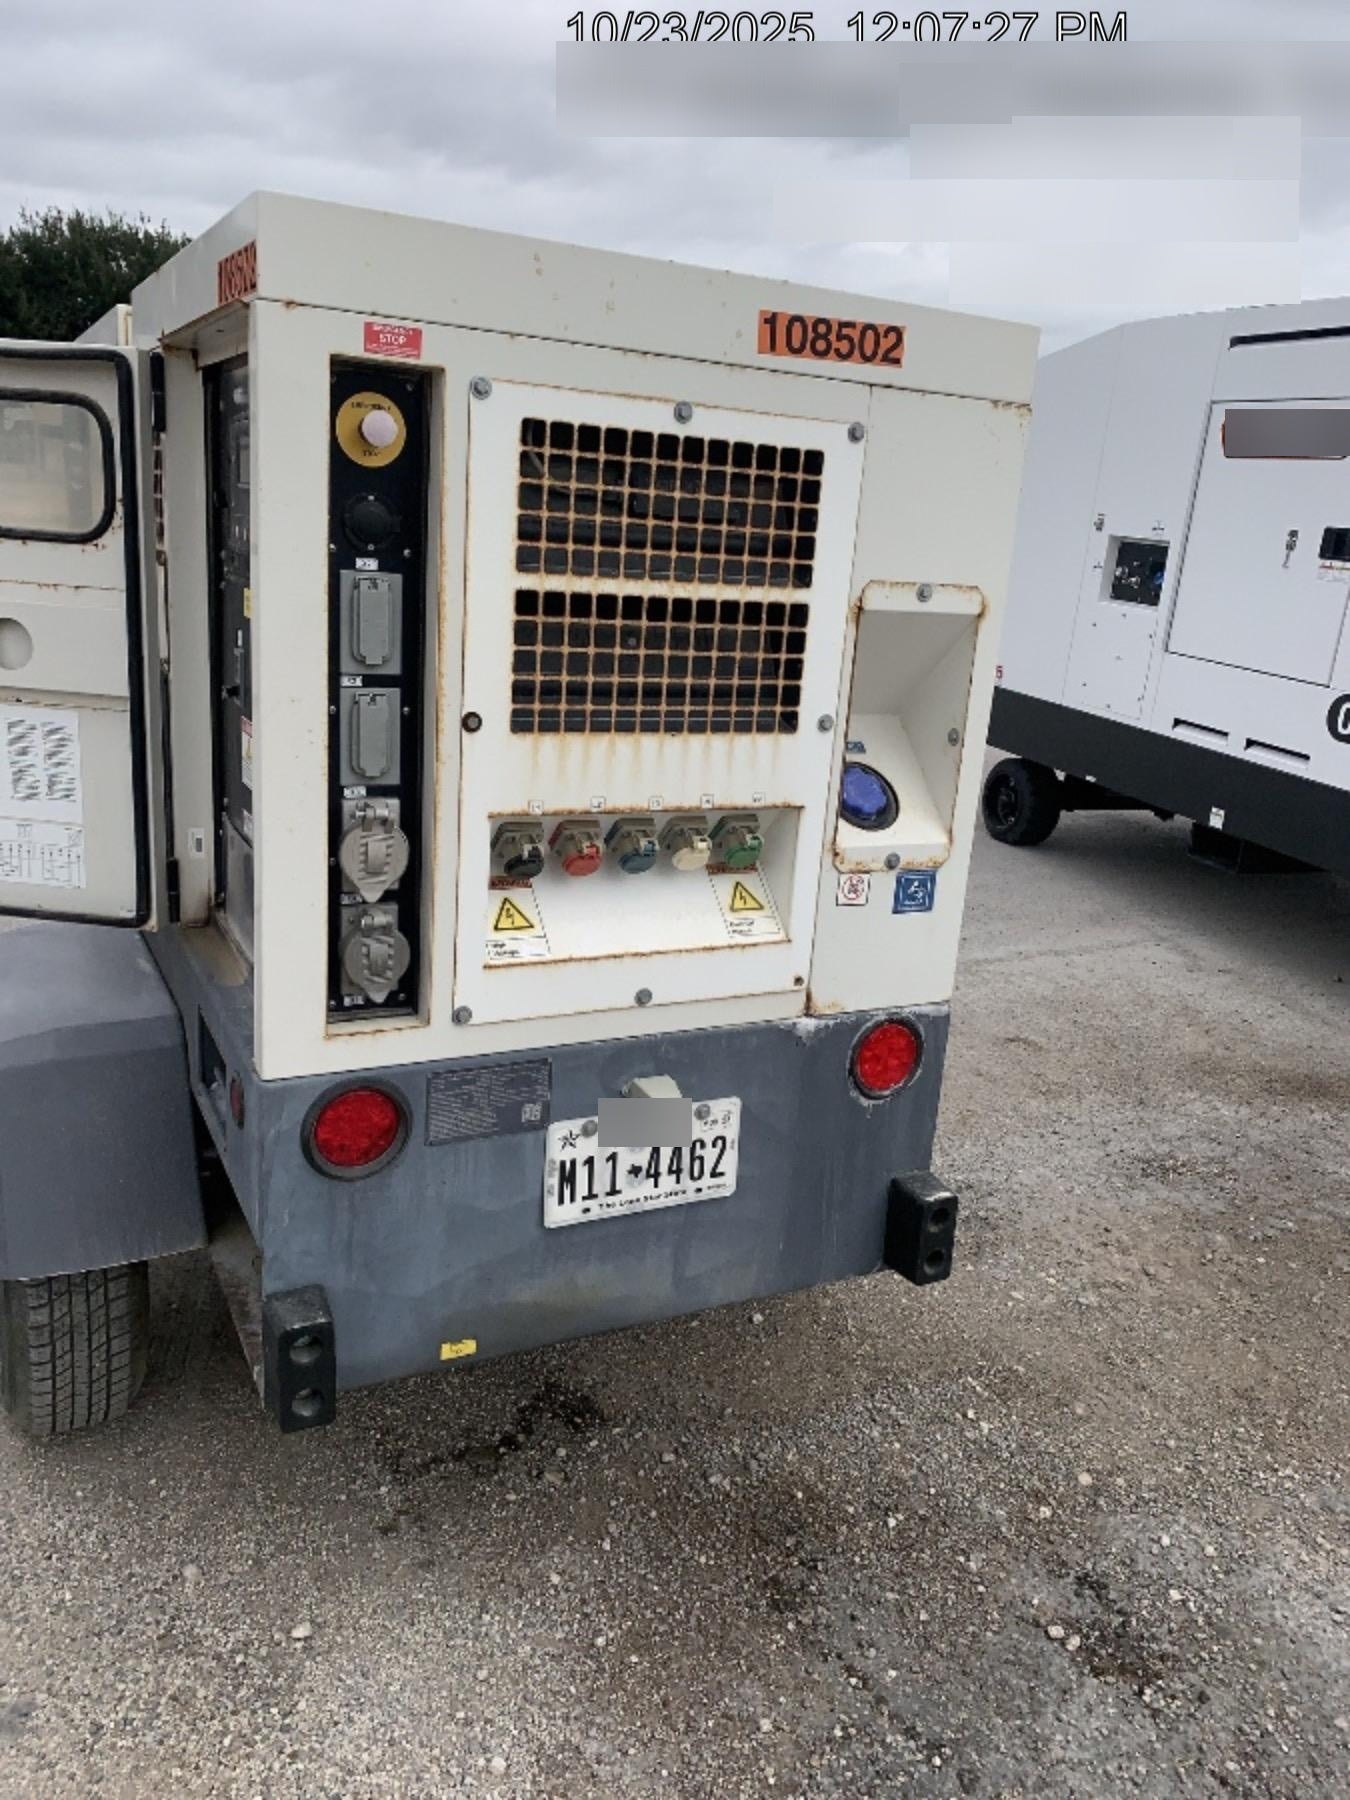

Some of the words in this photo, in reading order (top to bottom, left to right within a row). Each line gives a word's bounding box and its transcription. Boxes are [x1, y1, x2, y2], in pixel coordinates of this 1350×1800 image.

[379, 333, 407, 345] STOP
[763, 311, 904, 365] 108502
[558, 1151, 623, 1207] M11
[646, 1135, 727, 1188] 4462
